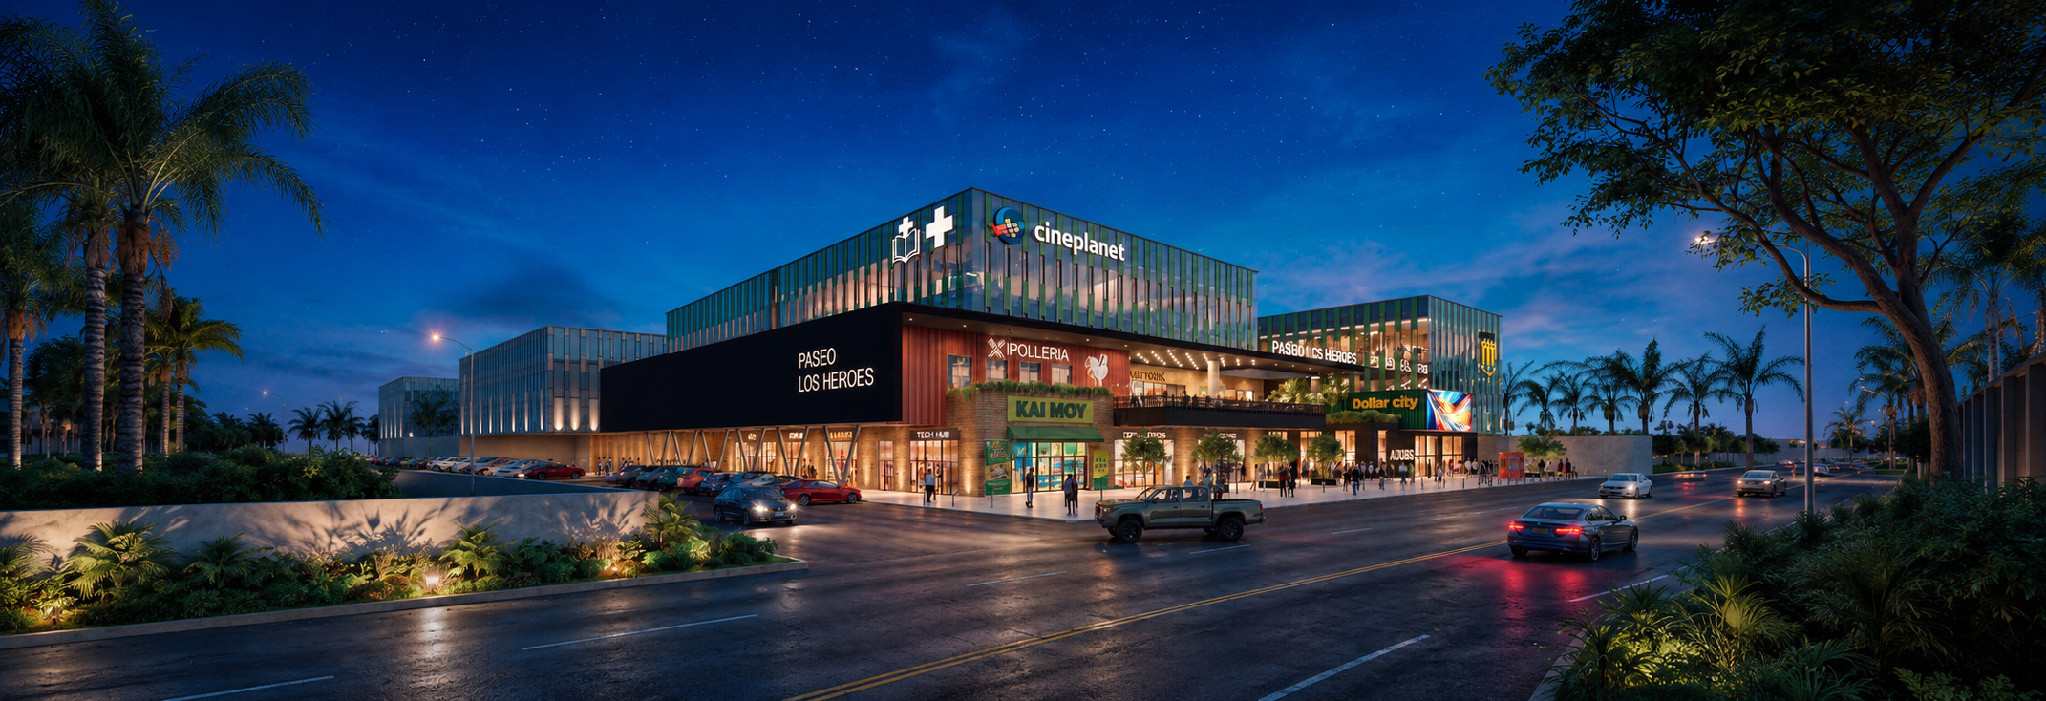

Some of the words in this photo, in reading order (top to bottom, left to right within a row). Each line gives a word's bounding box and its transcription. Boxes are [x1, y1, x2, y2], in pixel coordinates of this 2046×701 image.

[1033, 221, 1125, 262] cineplanet
[798, 347, 837, 369] PASEO
[798, 374, 820, 393] LOS
[822, 367, 874, 390] HEROES
[1015, 400, 1046, 418] KAI
[1050, 401, 1087, 419] MOY
[1352, 396, 1390, 409] Dollar
[1392, 394, 1418, 410] city
